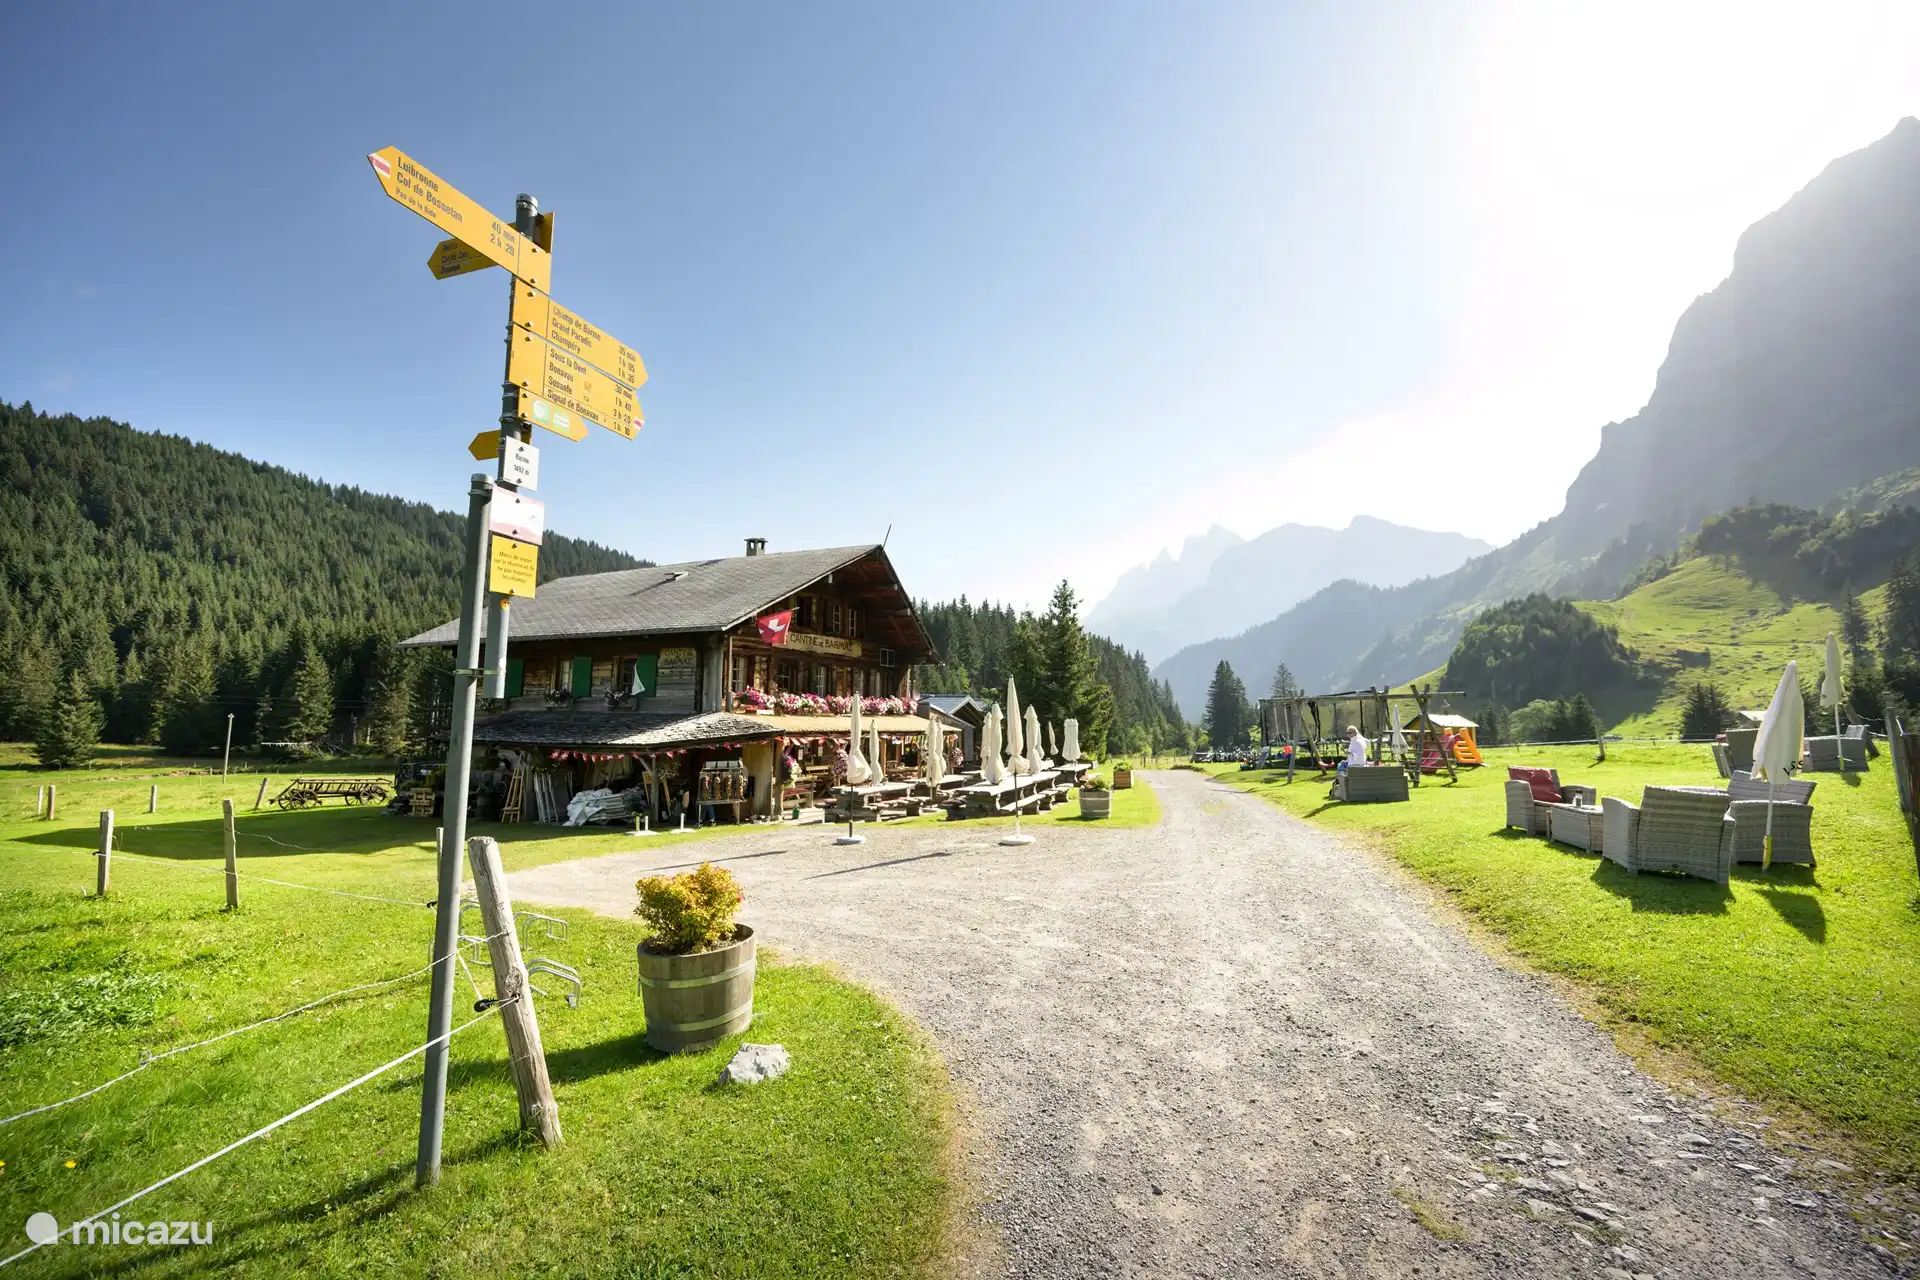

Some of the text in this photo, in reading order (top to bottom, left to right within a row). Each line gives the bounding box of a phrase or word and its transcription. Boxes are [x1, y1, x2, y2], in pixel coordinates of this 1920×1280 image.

[397, 172, 463, 222] Col de Bossetan
[492, 221, 516, 244] 40 min
[490, 233, 515, 256] 2 h 20
[552, 317, 570, 335] Grand
[553, 306, 574, 325] Champ
[549, 361, 574, 382] Bonavau
[573, 361, 587, 375] Dent
